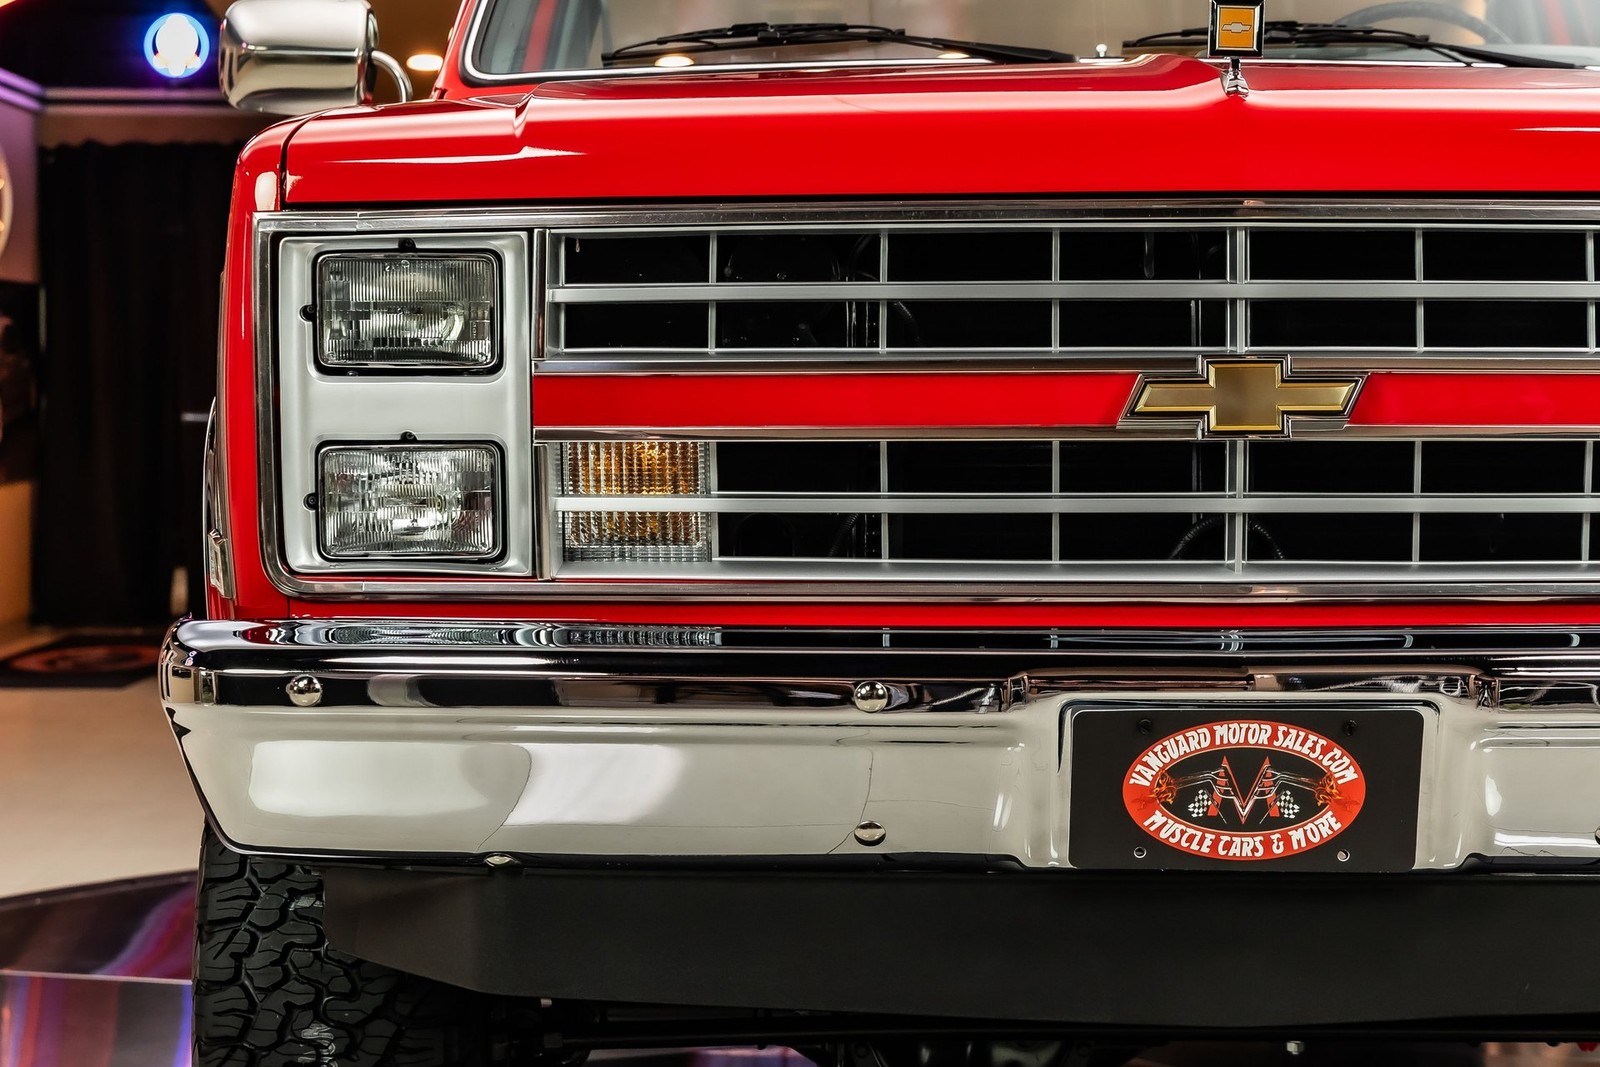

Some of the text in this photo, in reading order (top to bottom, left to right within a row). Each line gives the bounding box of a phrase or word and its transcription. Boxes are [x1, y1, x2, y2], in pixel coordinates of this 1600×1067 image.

[1129, 723, 1359, 787] VANGUARD MOTOR SALES.COM
[1143, 810, 1342, 857] MUSCLE CARS & MORE
